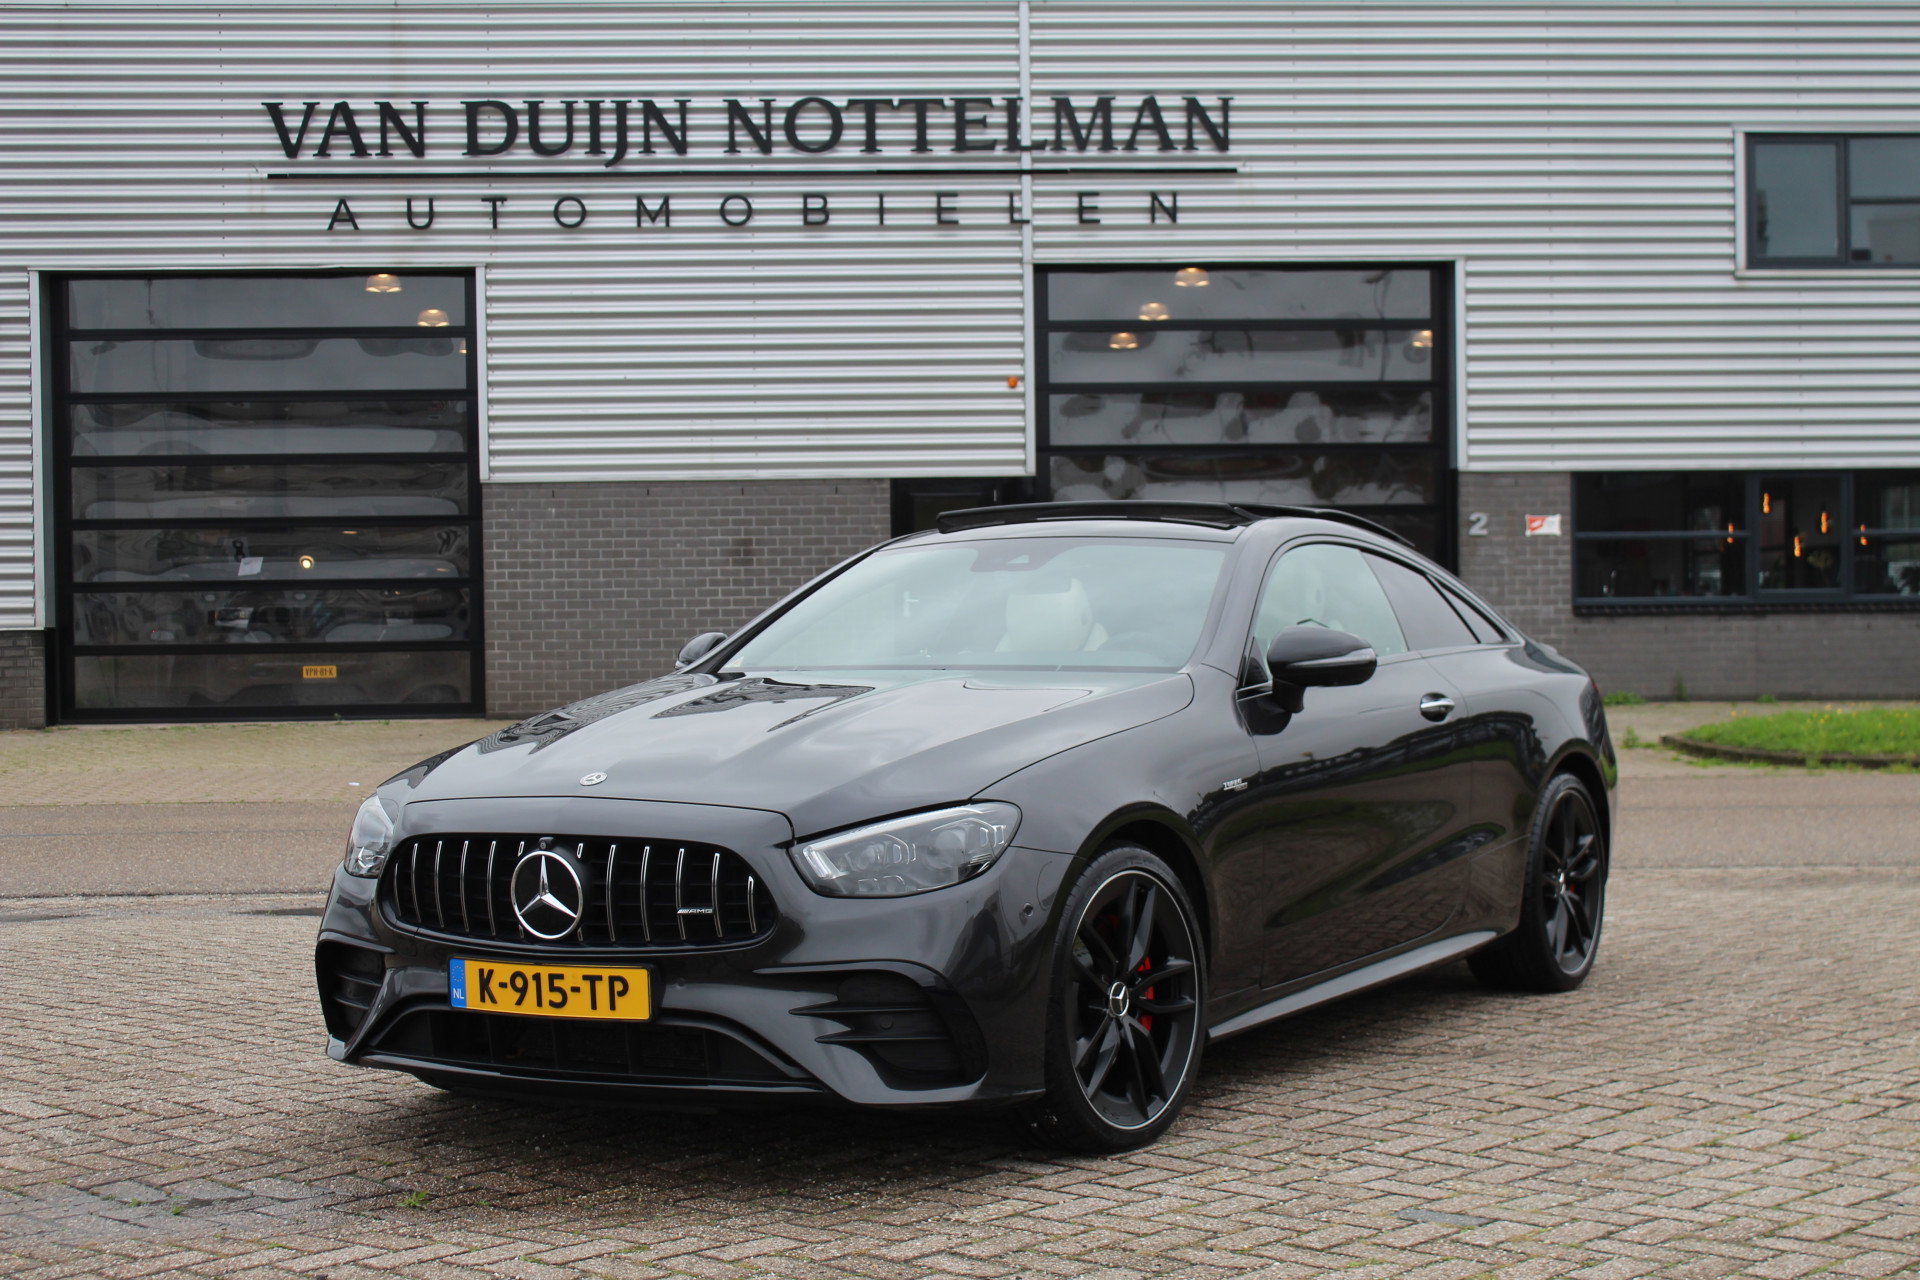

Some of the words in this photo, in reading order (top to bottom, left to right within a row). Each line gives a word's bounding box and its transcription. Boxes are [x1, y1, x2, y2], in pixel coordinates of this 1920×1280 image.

[261, 100, 429, 159] VAN
[460, 99, 692, 169] DUIJN
[722, 96, 1235, 155] NOTTELMAN
[327, 191, 1178, 231] AUTOMOBIELEN
[1468, 512, 1489, 536] 2
[453, 988, 465, 999] NL
[478, 967, 630, 1011] K-915-TP
